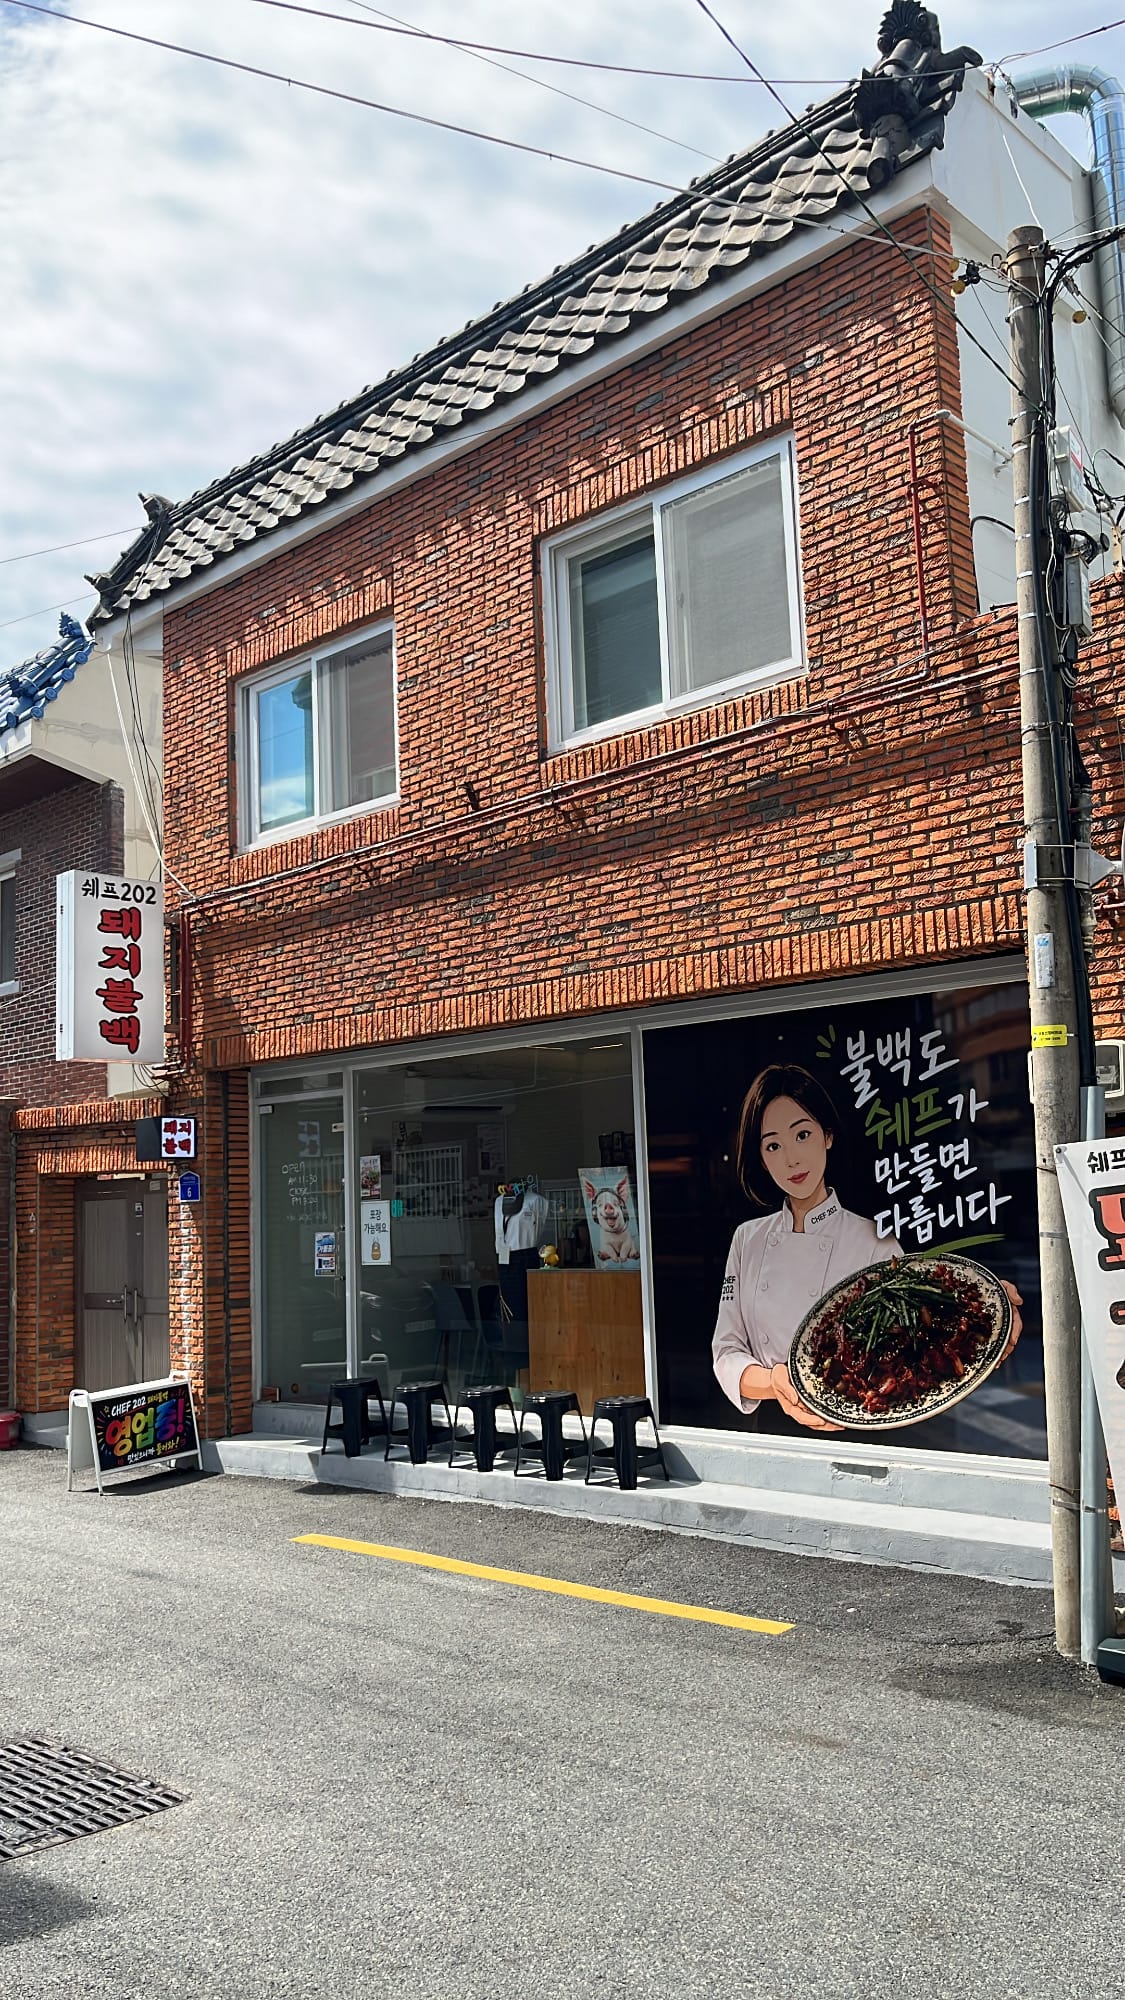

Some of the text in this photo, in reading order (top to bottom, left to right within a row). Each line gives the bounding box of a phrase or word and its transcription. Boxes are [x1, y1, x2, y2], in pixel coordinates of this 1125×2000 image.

[81, 877, 157, 905] 쉐프202
[96, 907, 143, 1054] 돼지불백
[839, 1027, 960, 1108] 불백도
[163, 1119, 191, 1136] 돼지
[865, 1087, 989, 1149] 쉐프가
[163, 1137, 191, 1155] 불백
[875, 1138, 977, 1194] 만들면
[187, 1187, 192, 1198] 6
[370, 1209, 382, 1221] 포장
[811, 1205, 838, 1224] CHEF 202
[874, 1182, 1012, 1244] 다릅니다
[364, 1222, 388, 1235] 가능해요
[111, 1402, 132, 1417] CHEF
[132, 1396, 147, 1410] 202
[105, 1398, 185, 1457] 영업중!
